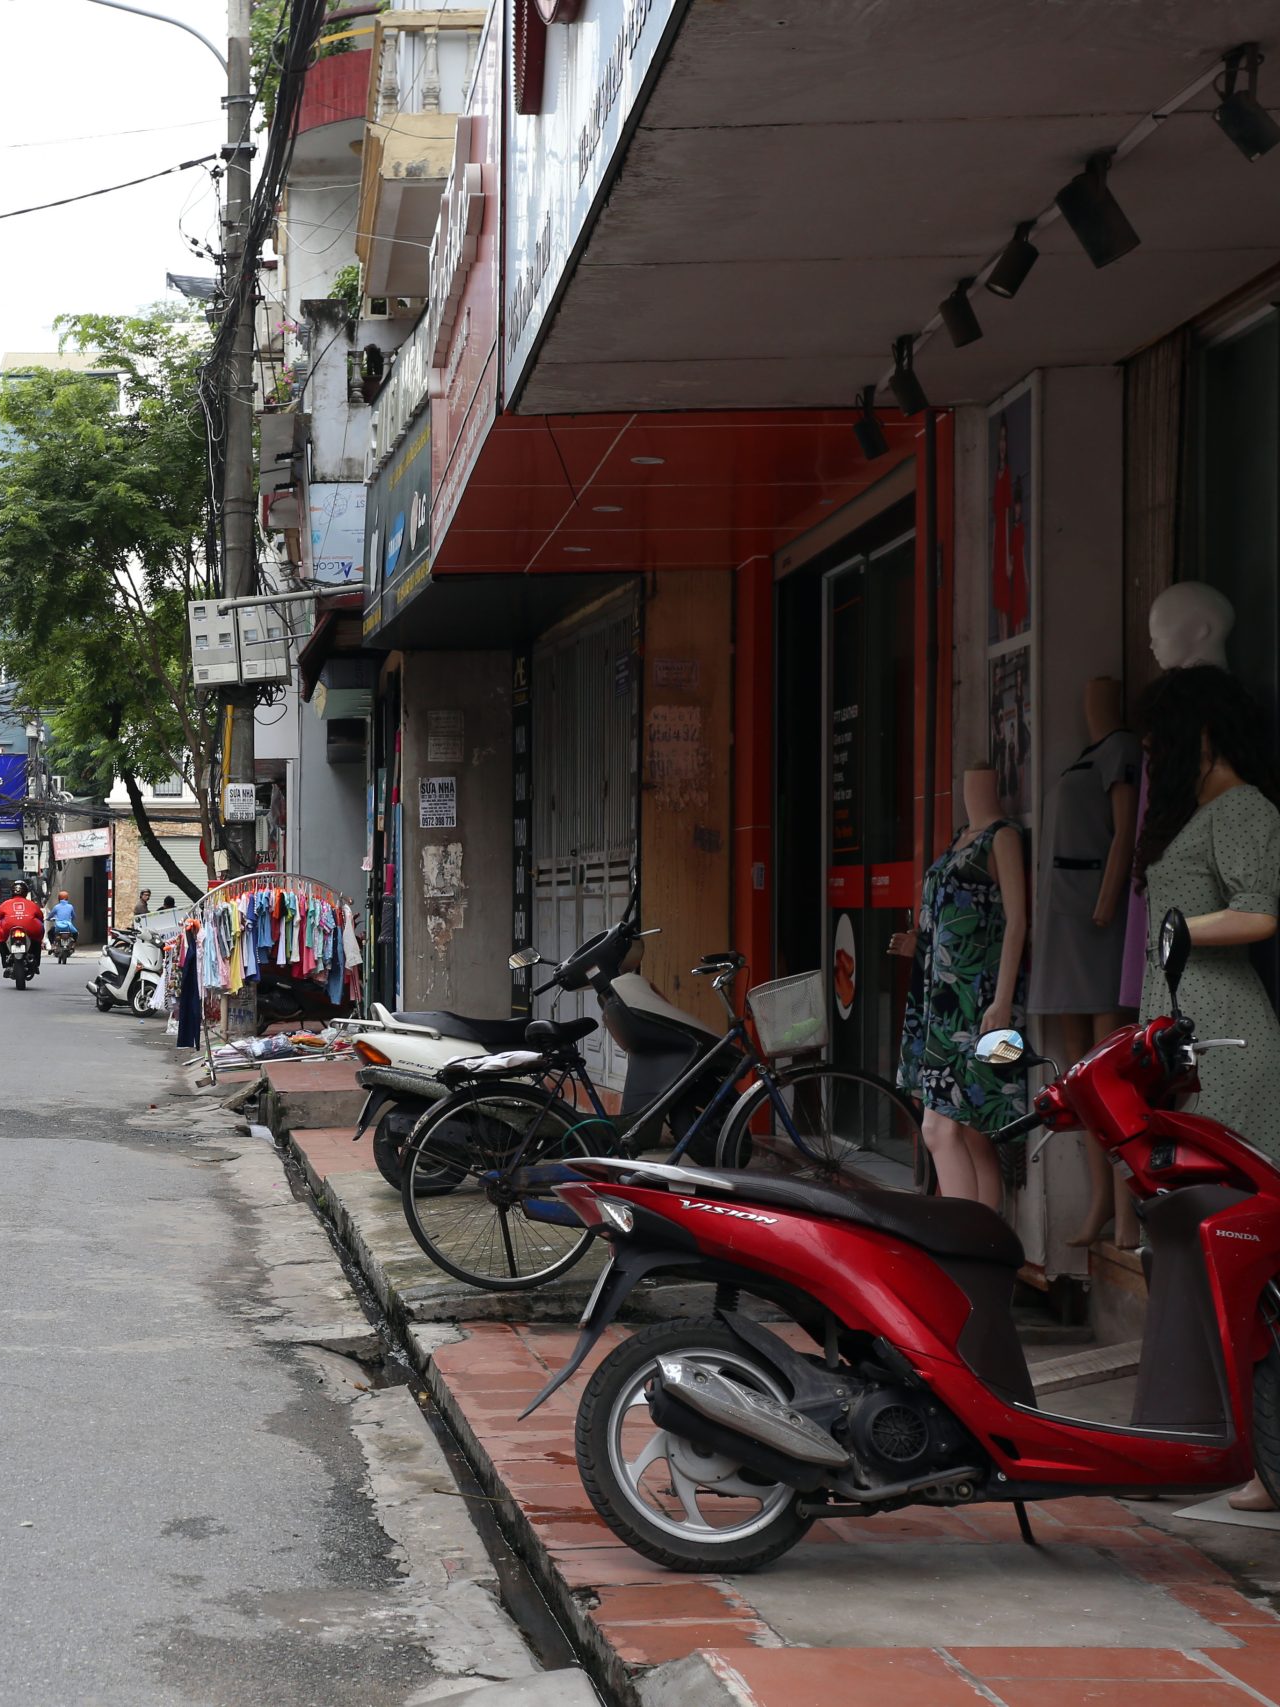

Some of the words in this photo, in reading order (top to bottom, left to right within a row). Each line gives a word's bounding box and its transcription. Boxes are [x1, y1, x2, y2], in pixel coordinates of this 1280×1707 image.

[418, 494, 426, 529] LG
[438, 779, 455, 793] NHÀ
[680, 1199, 778, 1224] VISION
[1216, 1230, 1261, 1241] HONDA
